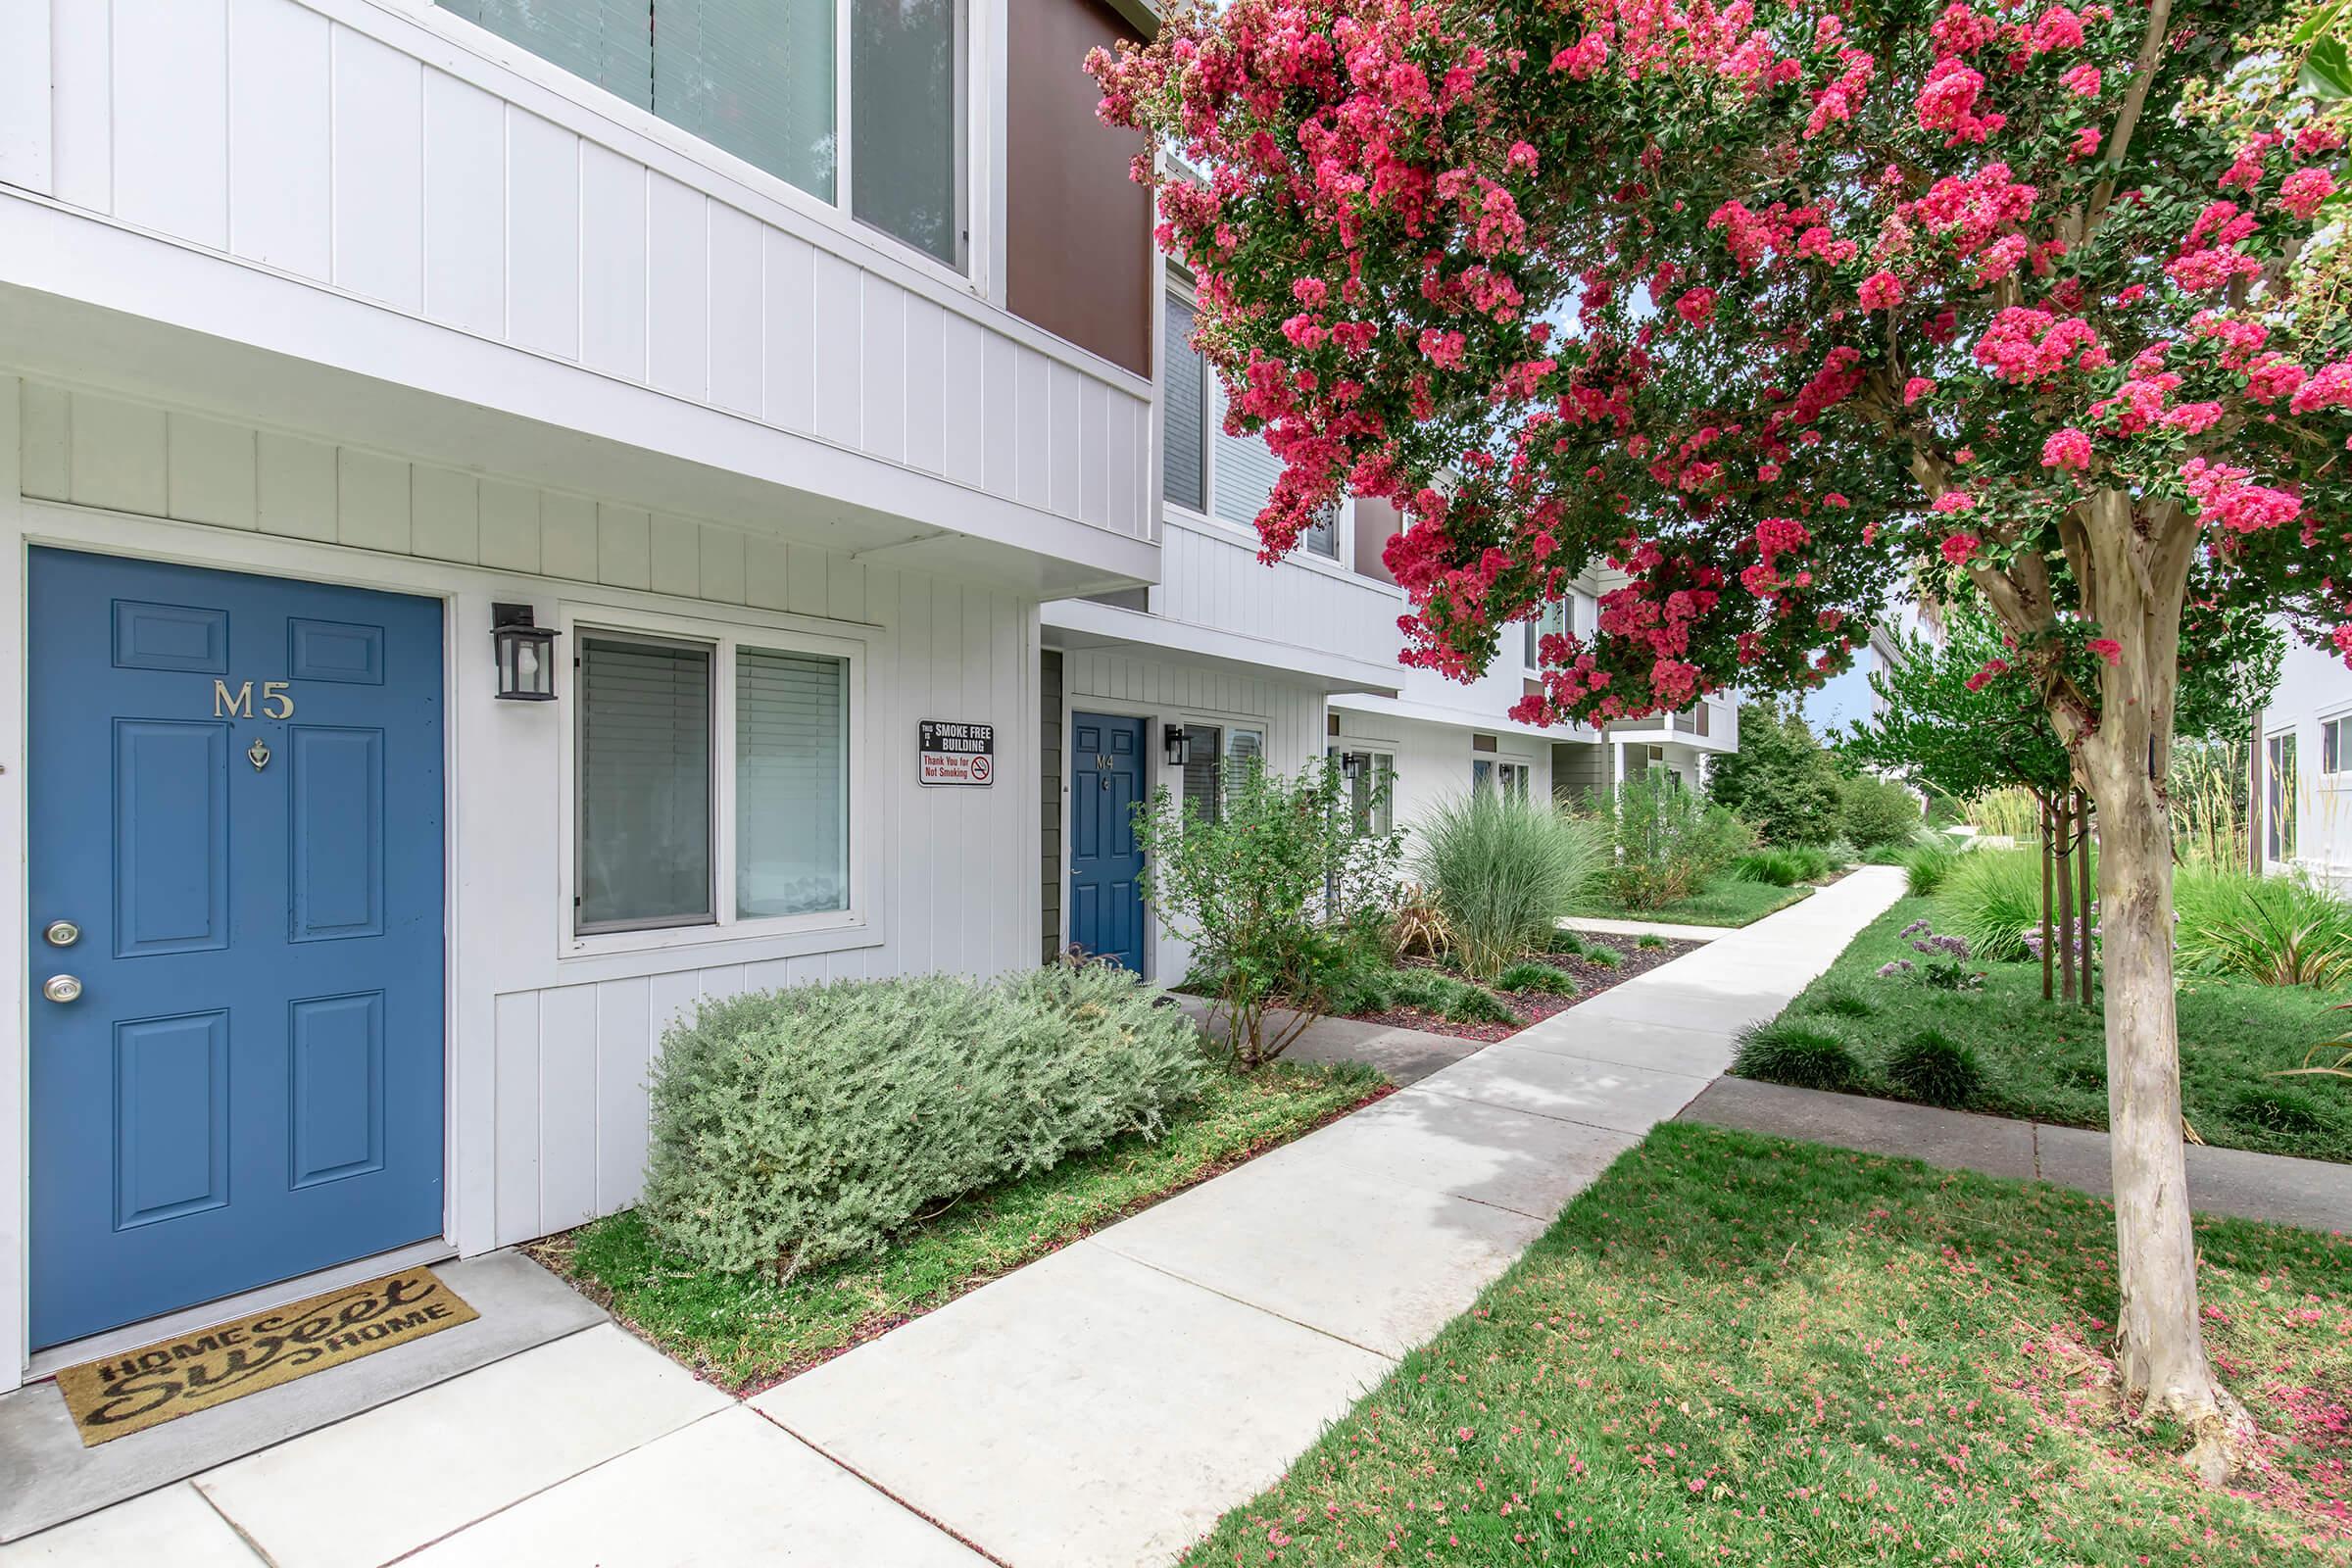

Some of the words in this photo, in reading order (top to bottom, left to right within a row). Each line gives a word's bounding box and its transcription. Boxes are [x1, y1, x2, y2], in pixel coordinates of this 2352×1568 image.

[214, 679, 294, 720] M5
[935, 723, 968, 738] SMOKE
[970, 726, 992, 739] FREE
[942, 738, 985, 753] BUILDING
[924, 755, 944, 765] Thank
[946, 757, 957, 766] You
[959, 758, 969, 766] for
[1097, 754, 1113, 769] M4
[925, 767, 937, 777] Not
[939, 767, 968, 779] Smoking
[326, 1302, 455, 1353] HOME
[85, 1278, 436, 1427] Sweet
[99, 1327, 251, 1383] HOME
